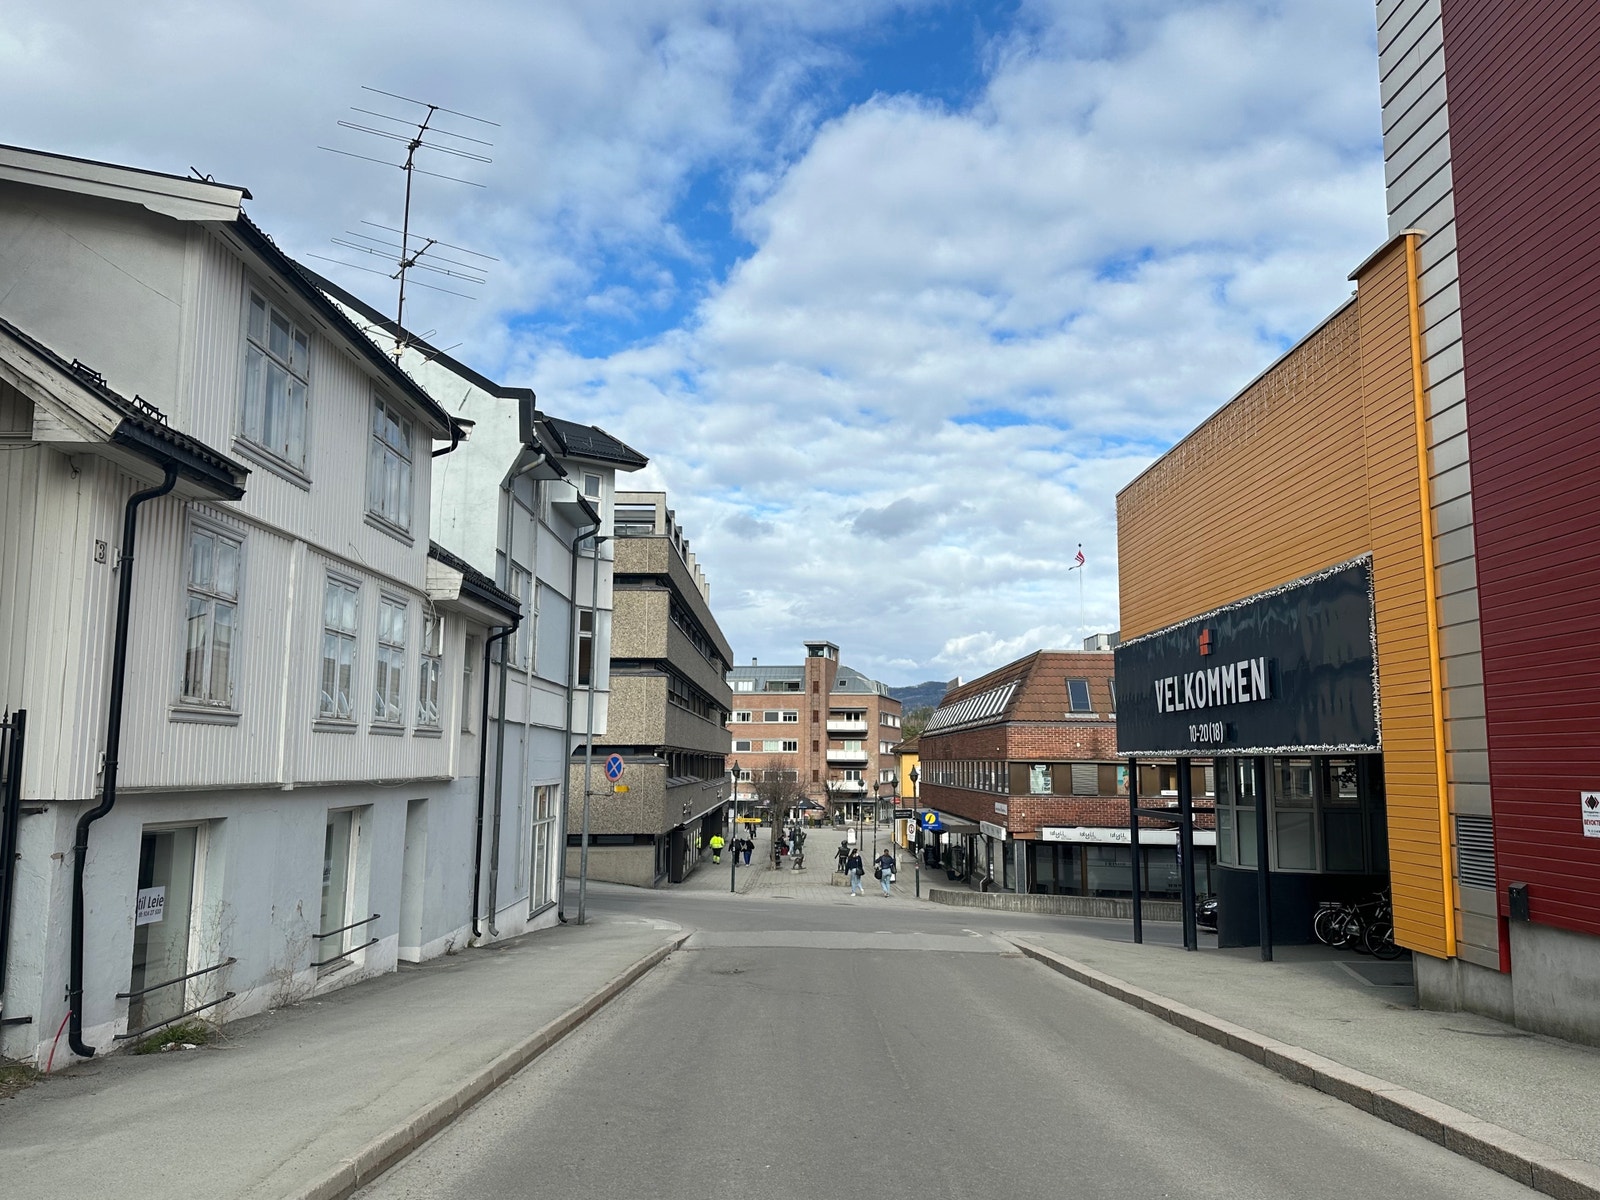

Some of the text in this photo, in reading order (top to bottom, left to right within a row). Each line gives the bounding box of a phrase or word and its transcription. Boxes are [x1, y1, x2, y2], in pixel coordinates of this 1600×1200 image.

[99, 544, 106, 560] 3
[1155, 656, 1266, 714] VELKOMMEN
[1188, 720, 1224, 744] 10-20(18)
[138, 894, 164, 910] til Leie
